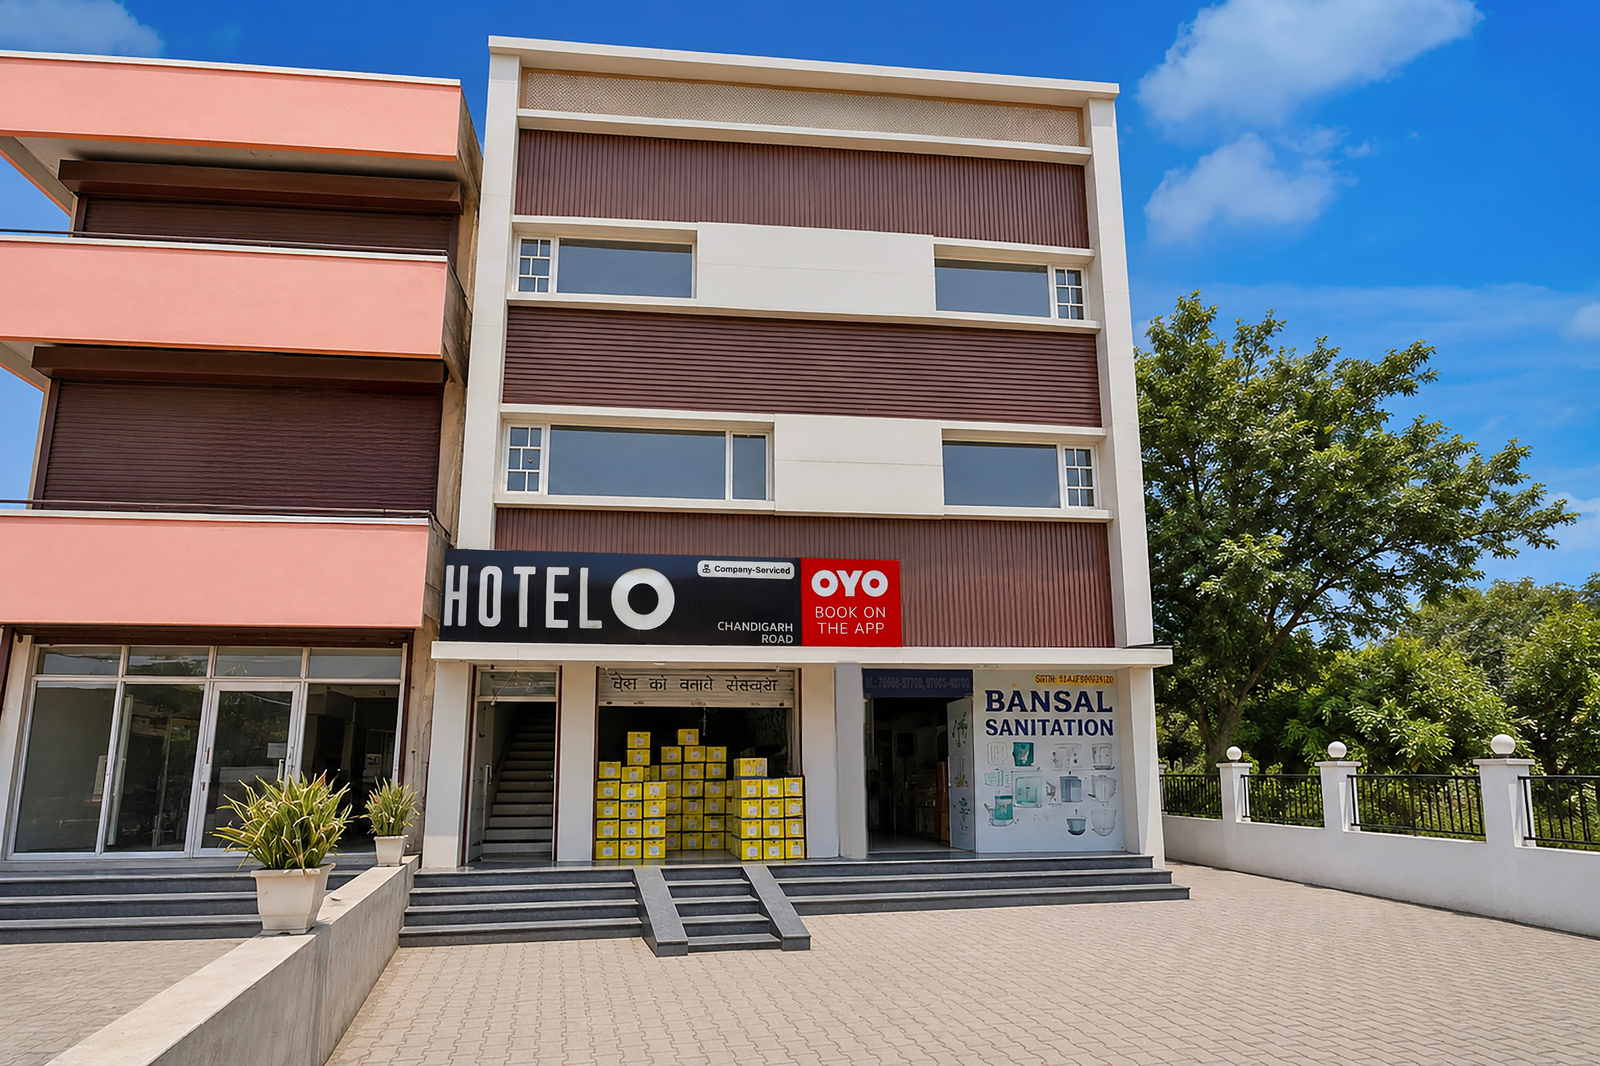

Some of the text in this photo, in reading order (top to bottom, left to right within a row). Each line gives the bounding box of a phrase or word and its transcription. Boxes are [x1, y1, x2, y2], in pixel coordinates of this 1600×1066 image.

[714, 565, 790, 575] Company-Serviced
[811, 569, 889, 597] OYO
[444, 565, 675, 630] HOTEL O
[815, 606, 886, 618] BOOK ON
[717, 621, 793, 632] CHANDIGARH
[817, 622, 884, 634] THE APP
[761, 634, 793, 644] ROAD
[985, 690, 1113, 712] BANSAL
[985, 718, 1114, 736] SANITATION
